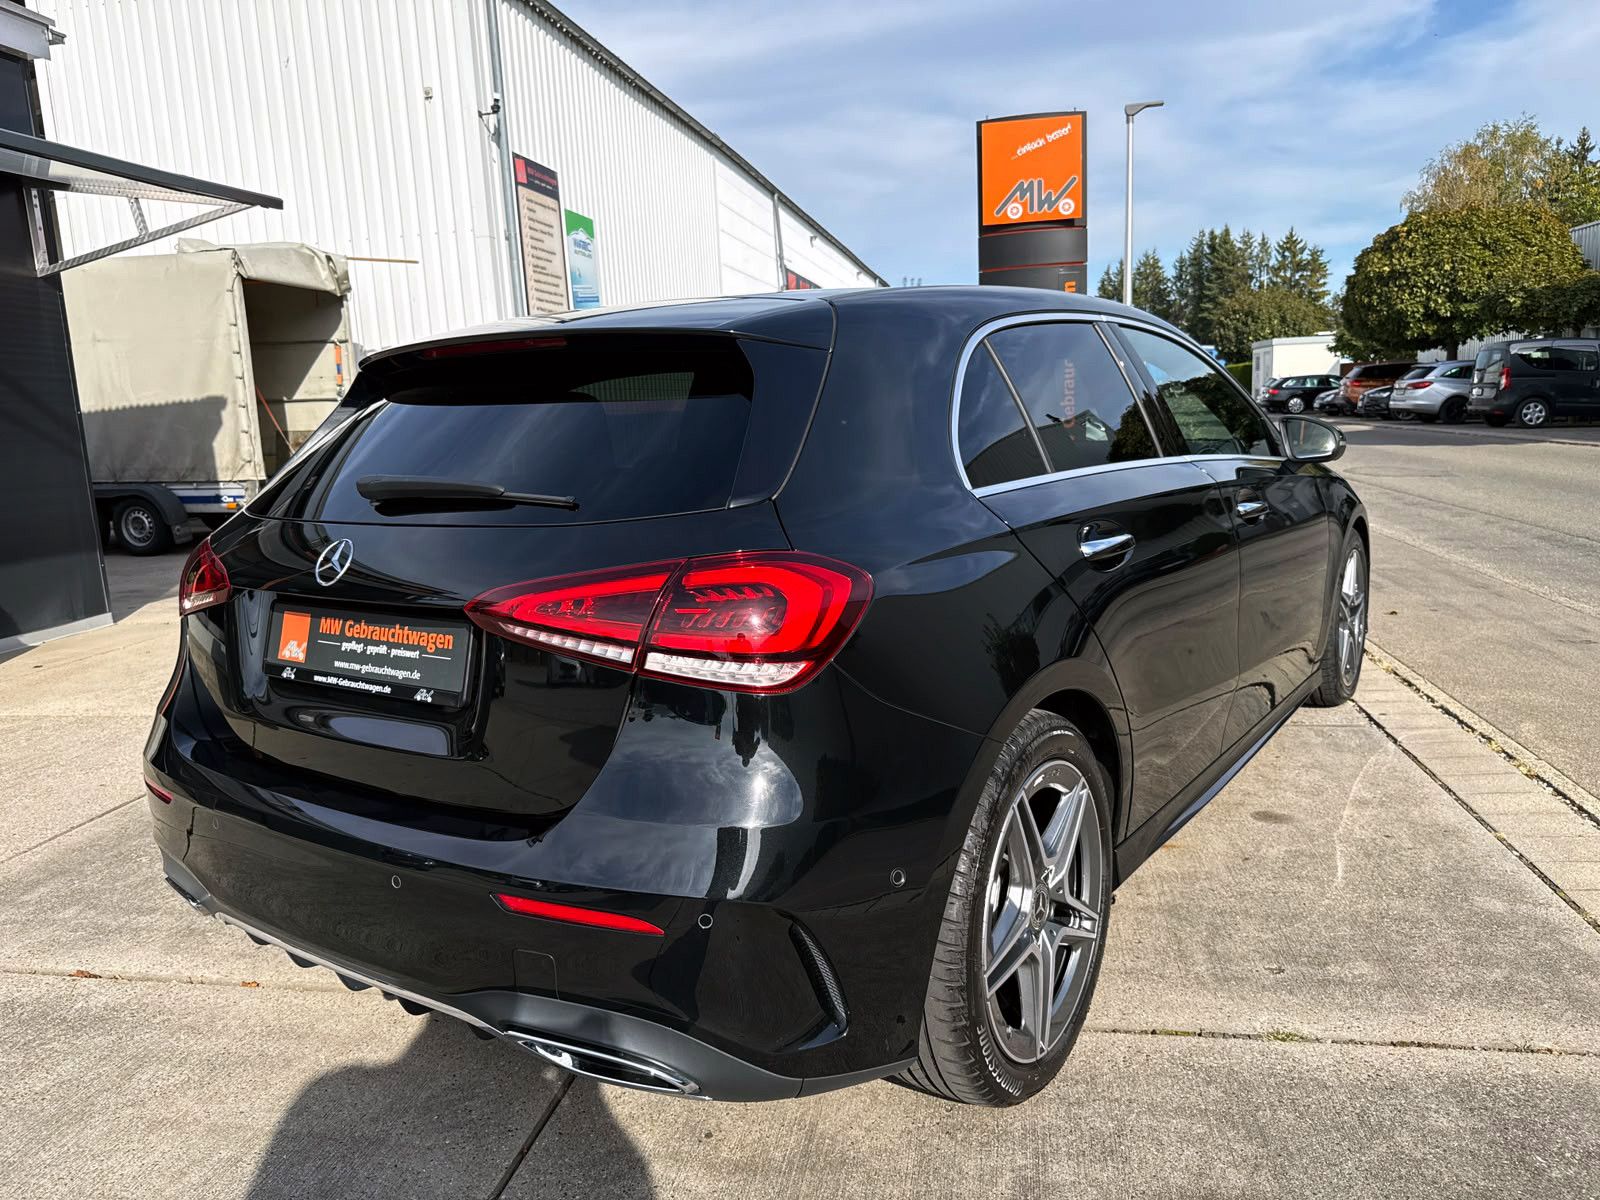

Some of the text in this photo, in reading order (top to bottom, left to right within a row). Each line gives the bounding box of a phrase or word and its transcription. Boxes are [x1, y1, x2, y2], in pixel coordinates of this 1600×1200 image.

[994, 175, 1078, 219] MW
[319, 616, 454, 653] MW Gebrauchtwagen
[390, 647, 420, 659] preiswert
[333, 660, 421, 680] www.mw-gebrauchtwagen.de
